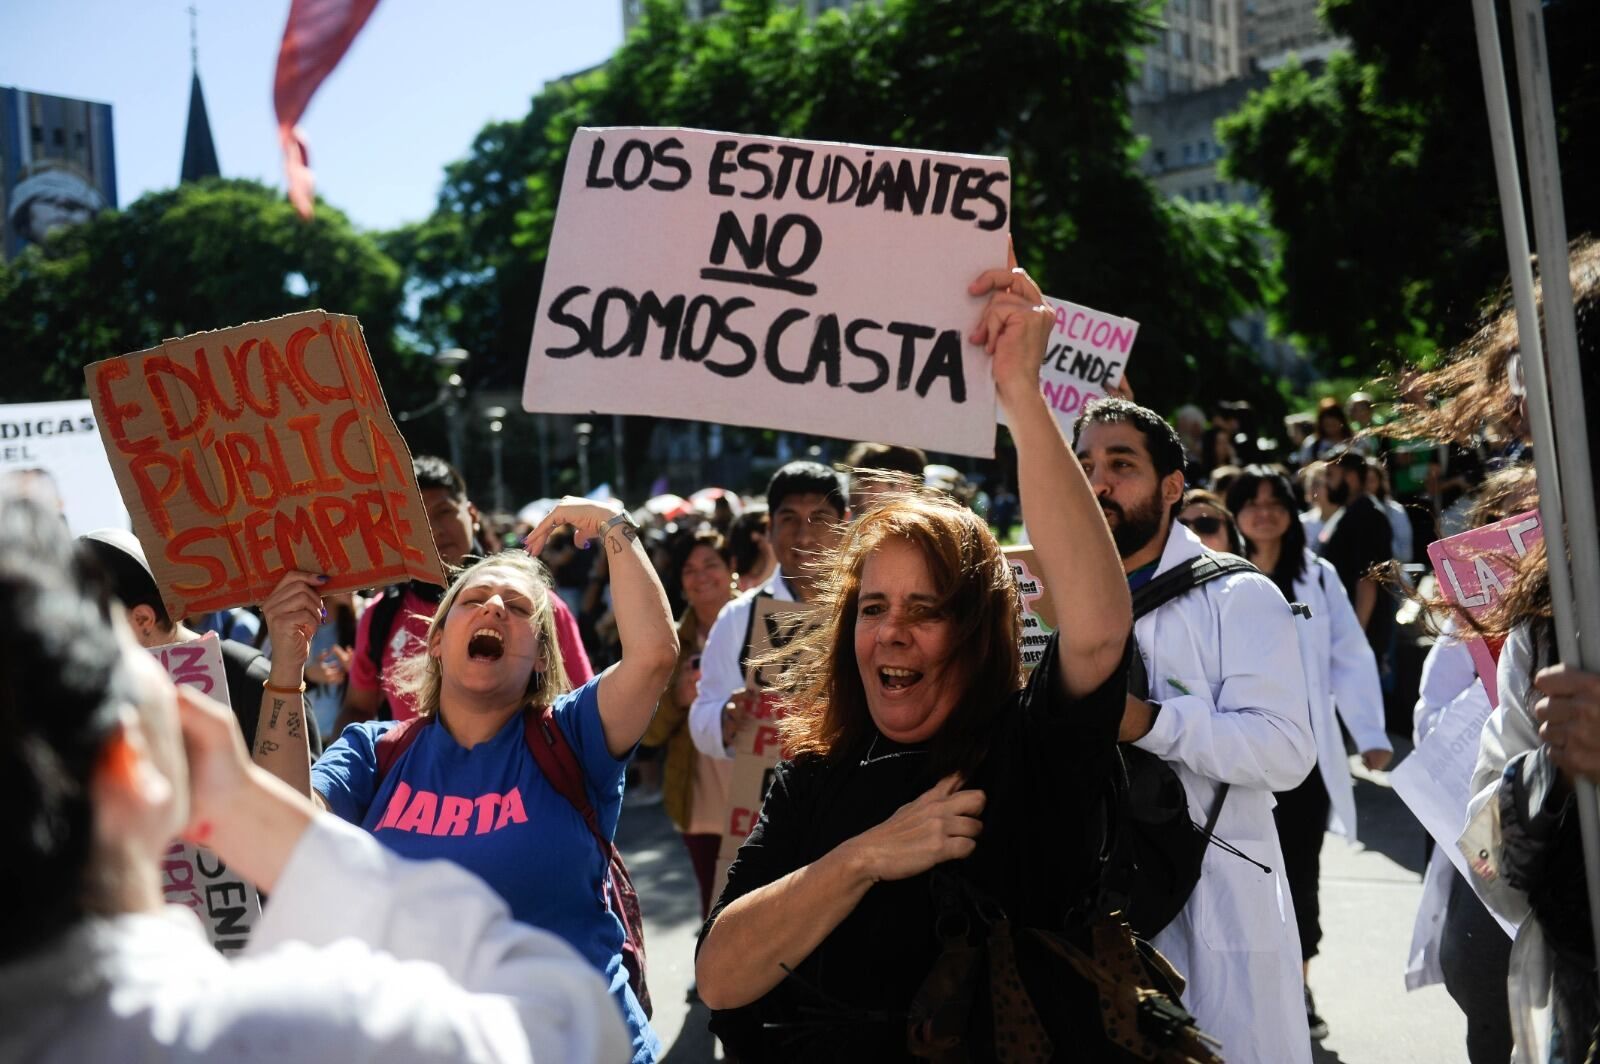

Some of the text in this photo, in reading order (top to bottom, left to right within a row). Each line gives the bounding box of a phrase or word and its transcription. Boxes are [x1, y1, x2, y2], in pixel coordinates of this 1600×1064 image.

[586, 137, 692, 191] LOS
[709, 210, 822, 277] NO
[545, 286, 966, 403] SOMOS CASTA
[128, 408, 409, 541] PÚBLICA
[165, 490, 426, 598] SIEMPRE
